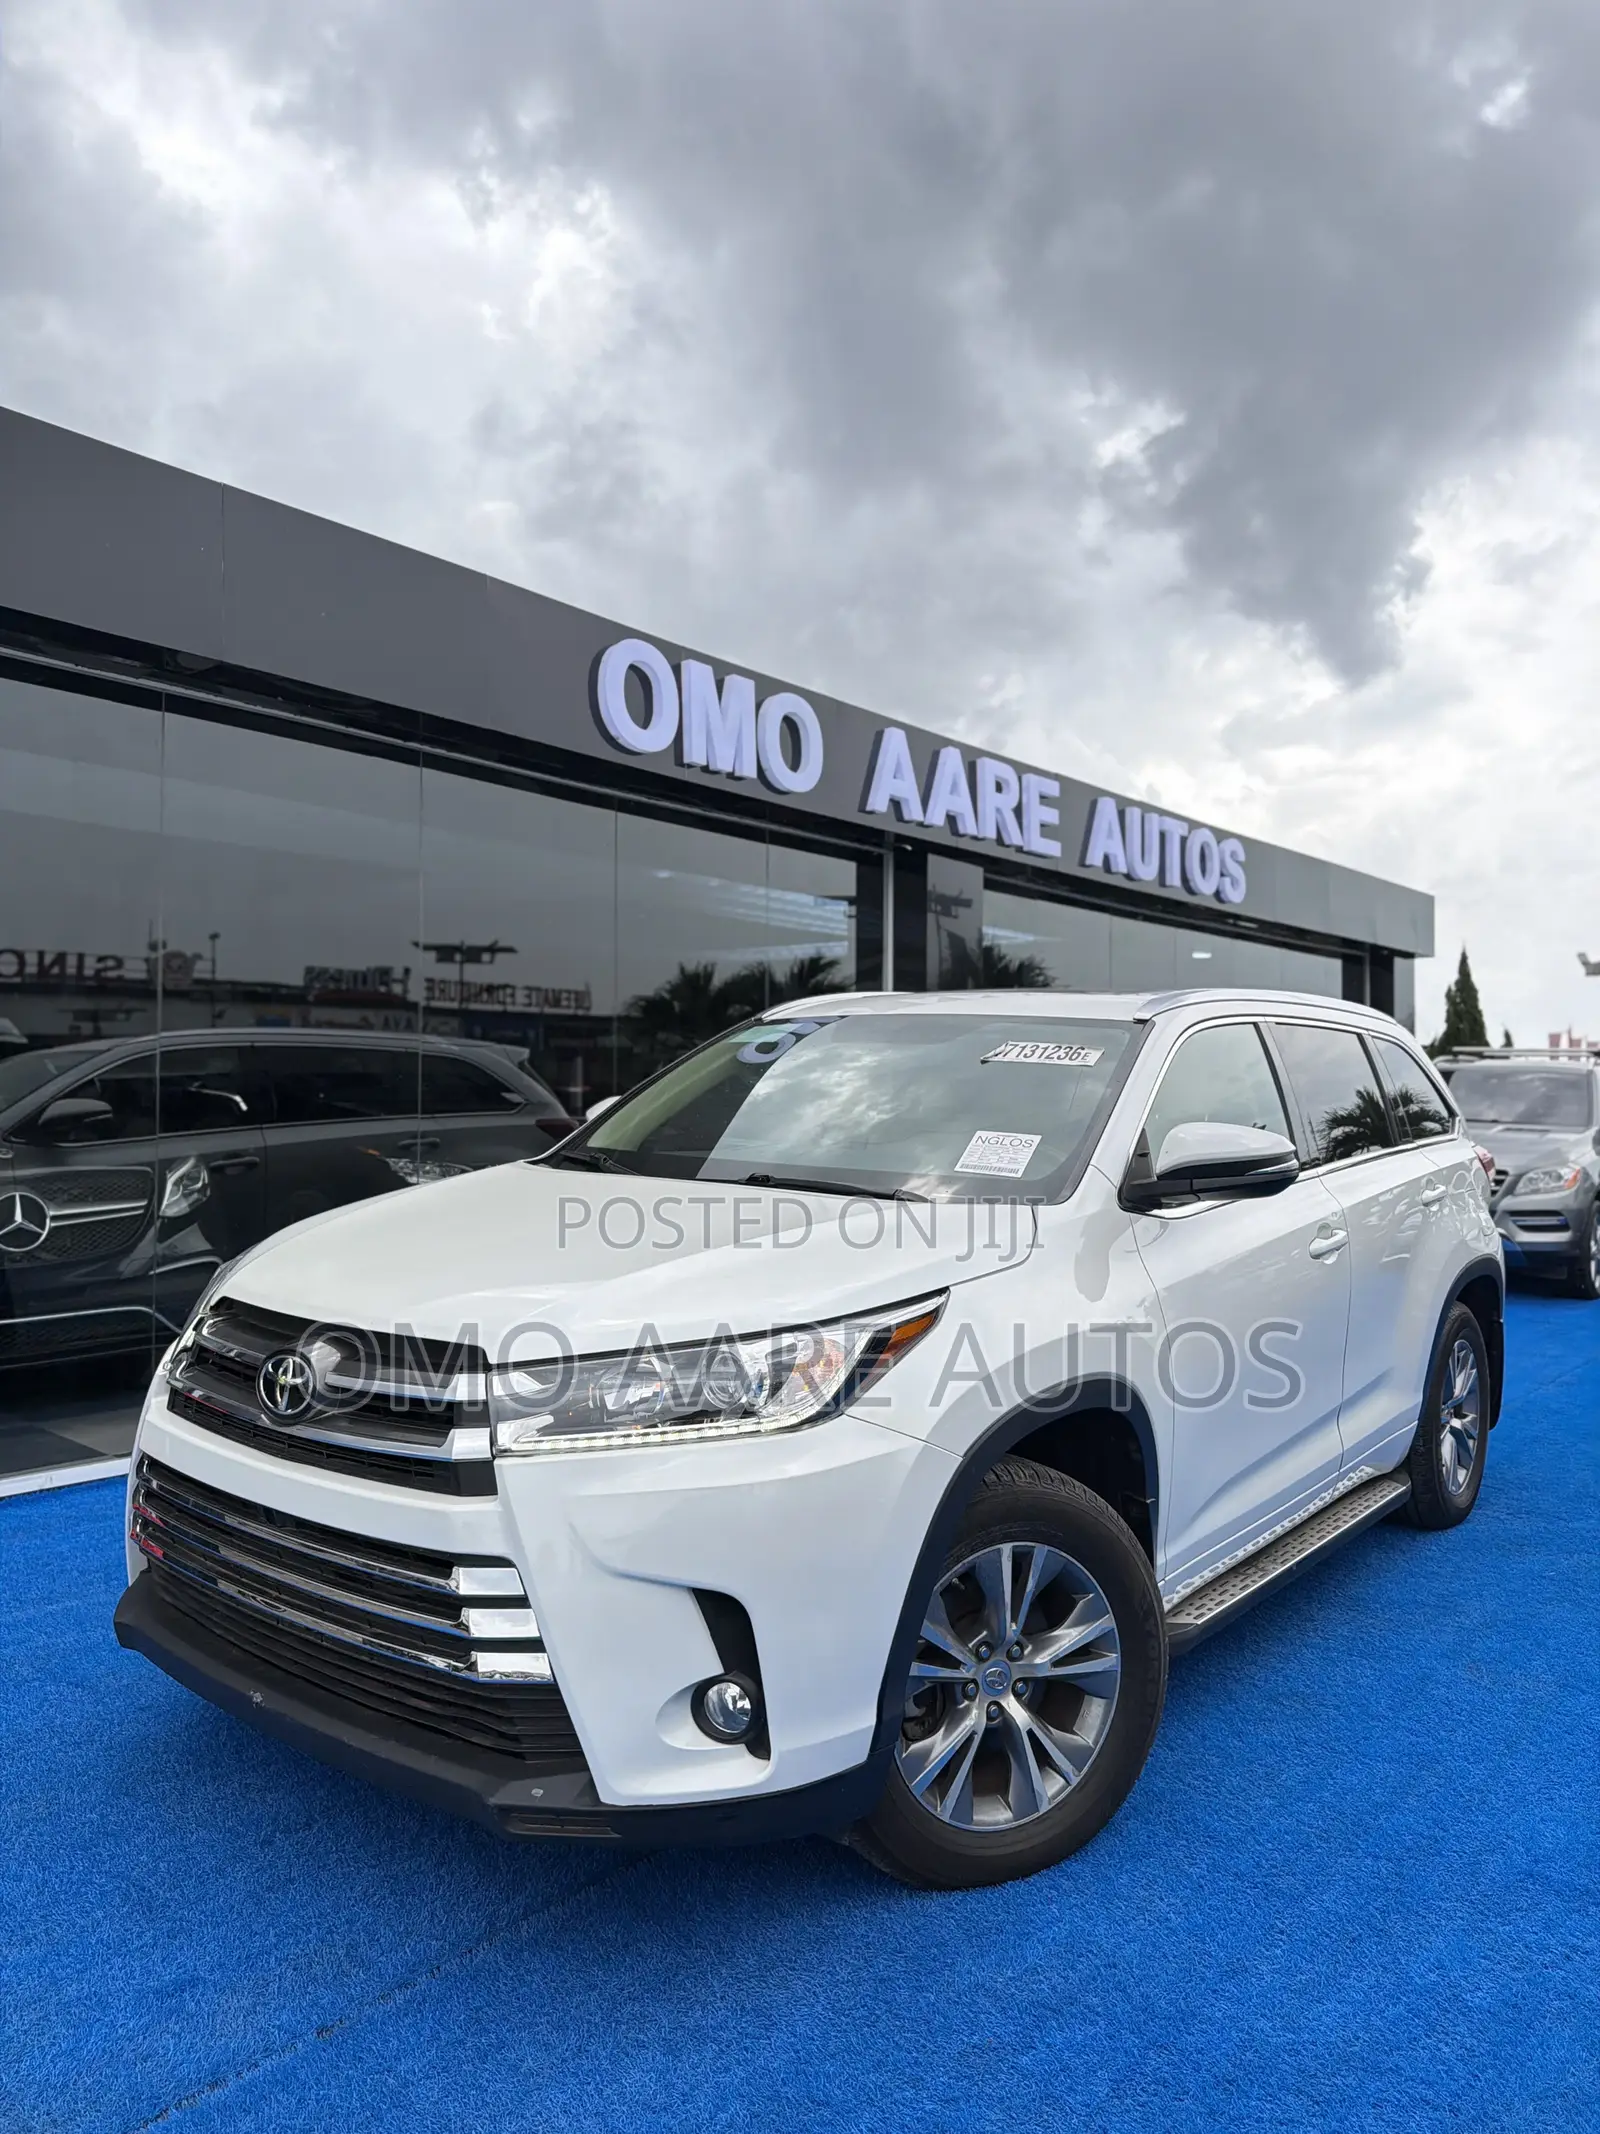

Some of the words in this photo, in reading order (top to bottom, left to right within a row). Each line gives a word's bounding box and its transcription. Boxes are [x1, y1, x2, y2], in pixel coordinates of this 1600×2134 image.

[594, 638, 824, 793] OMO
[864, 726, 1062, 858] AARE
[1084, 796, 1247, 904] AUTOS
[974, 1135, 1035, 1148] NGLOS
